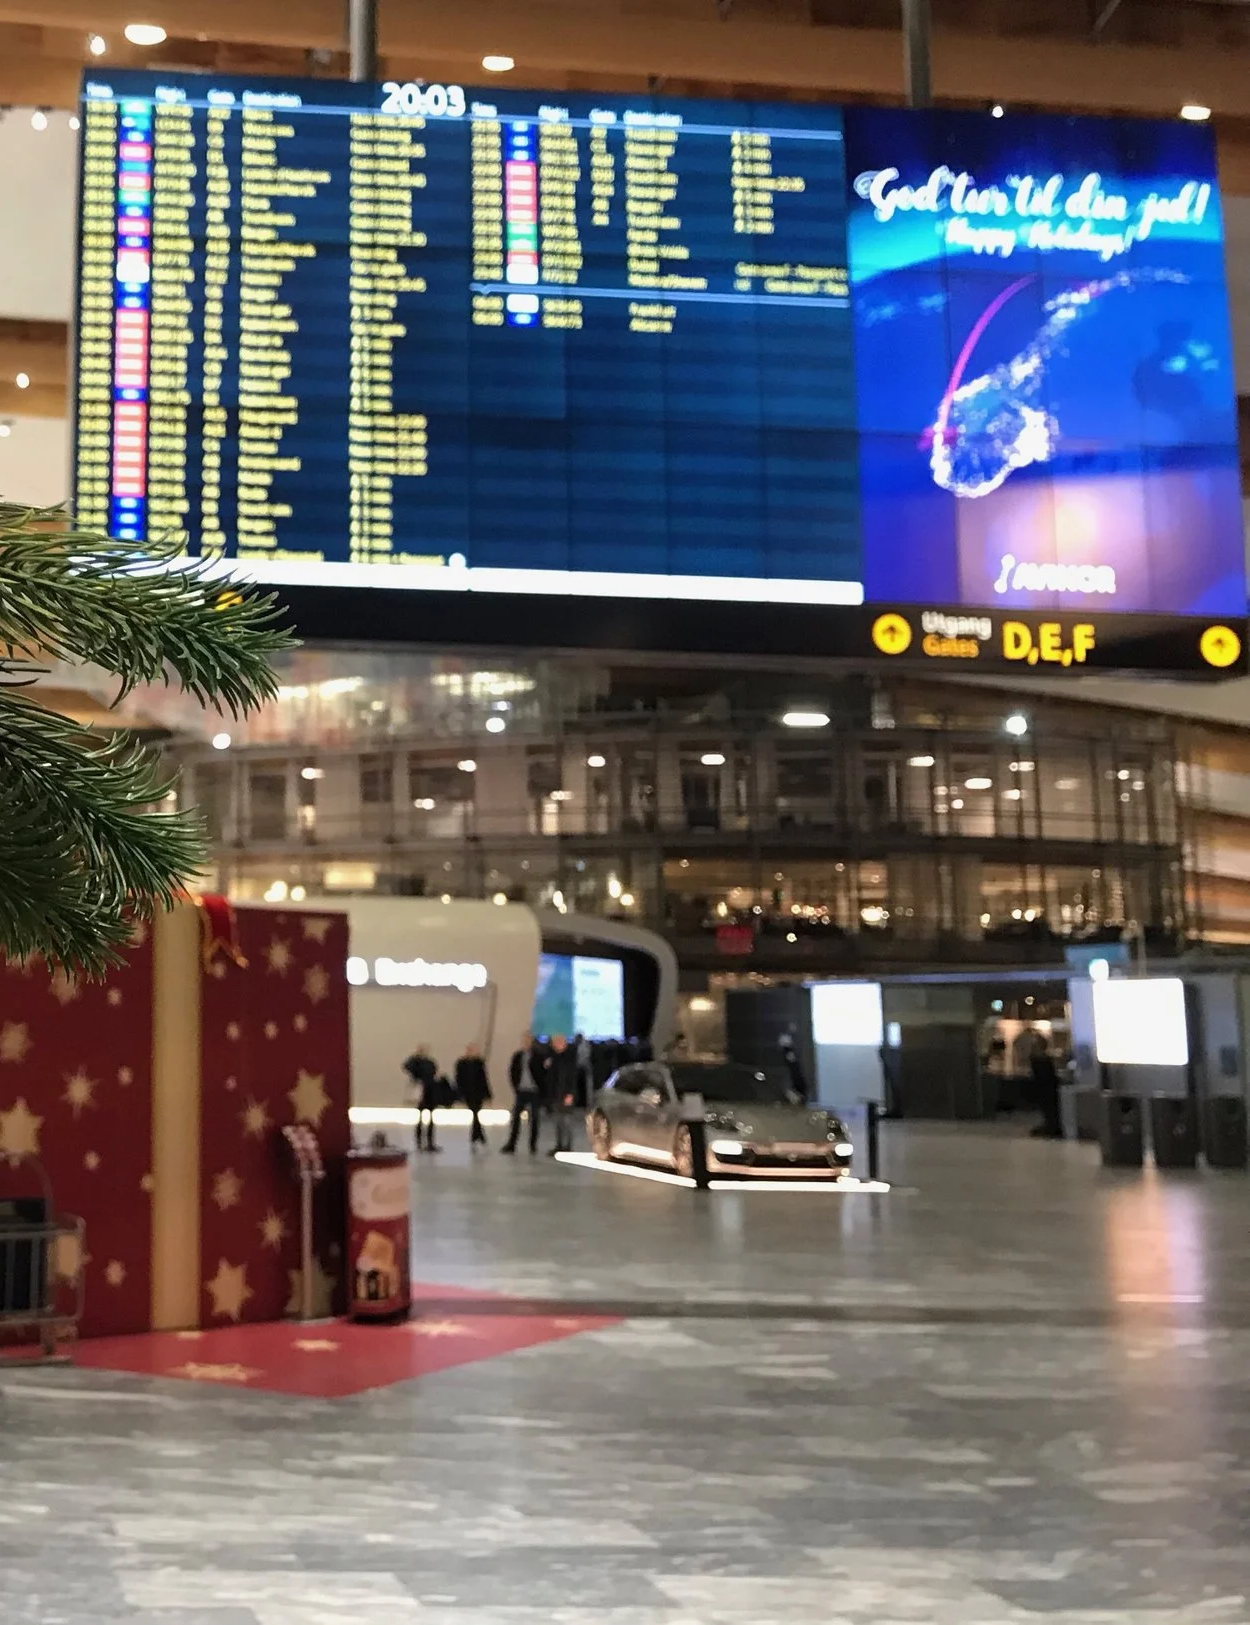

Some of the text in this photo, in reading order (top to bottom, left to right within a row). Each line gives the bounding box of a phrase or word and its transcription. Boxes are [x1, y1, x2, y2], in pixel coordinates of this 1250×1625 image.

[381, 82, 466, 117] 20:03
[854, 165, 952, 222] God
[922, 611, 992, 640] Utgang
[922, 634, 979, 658] Gates
